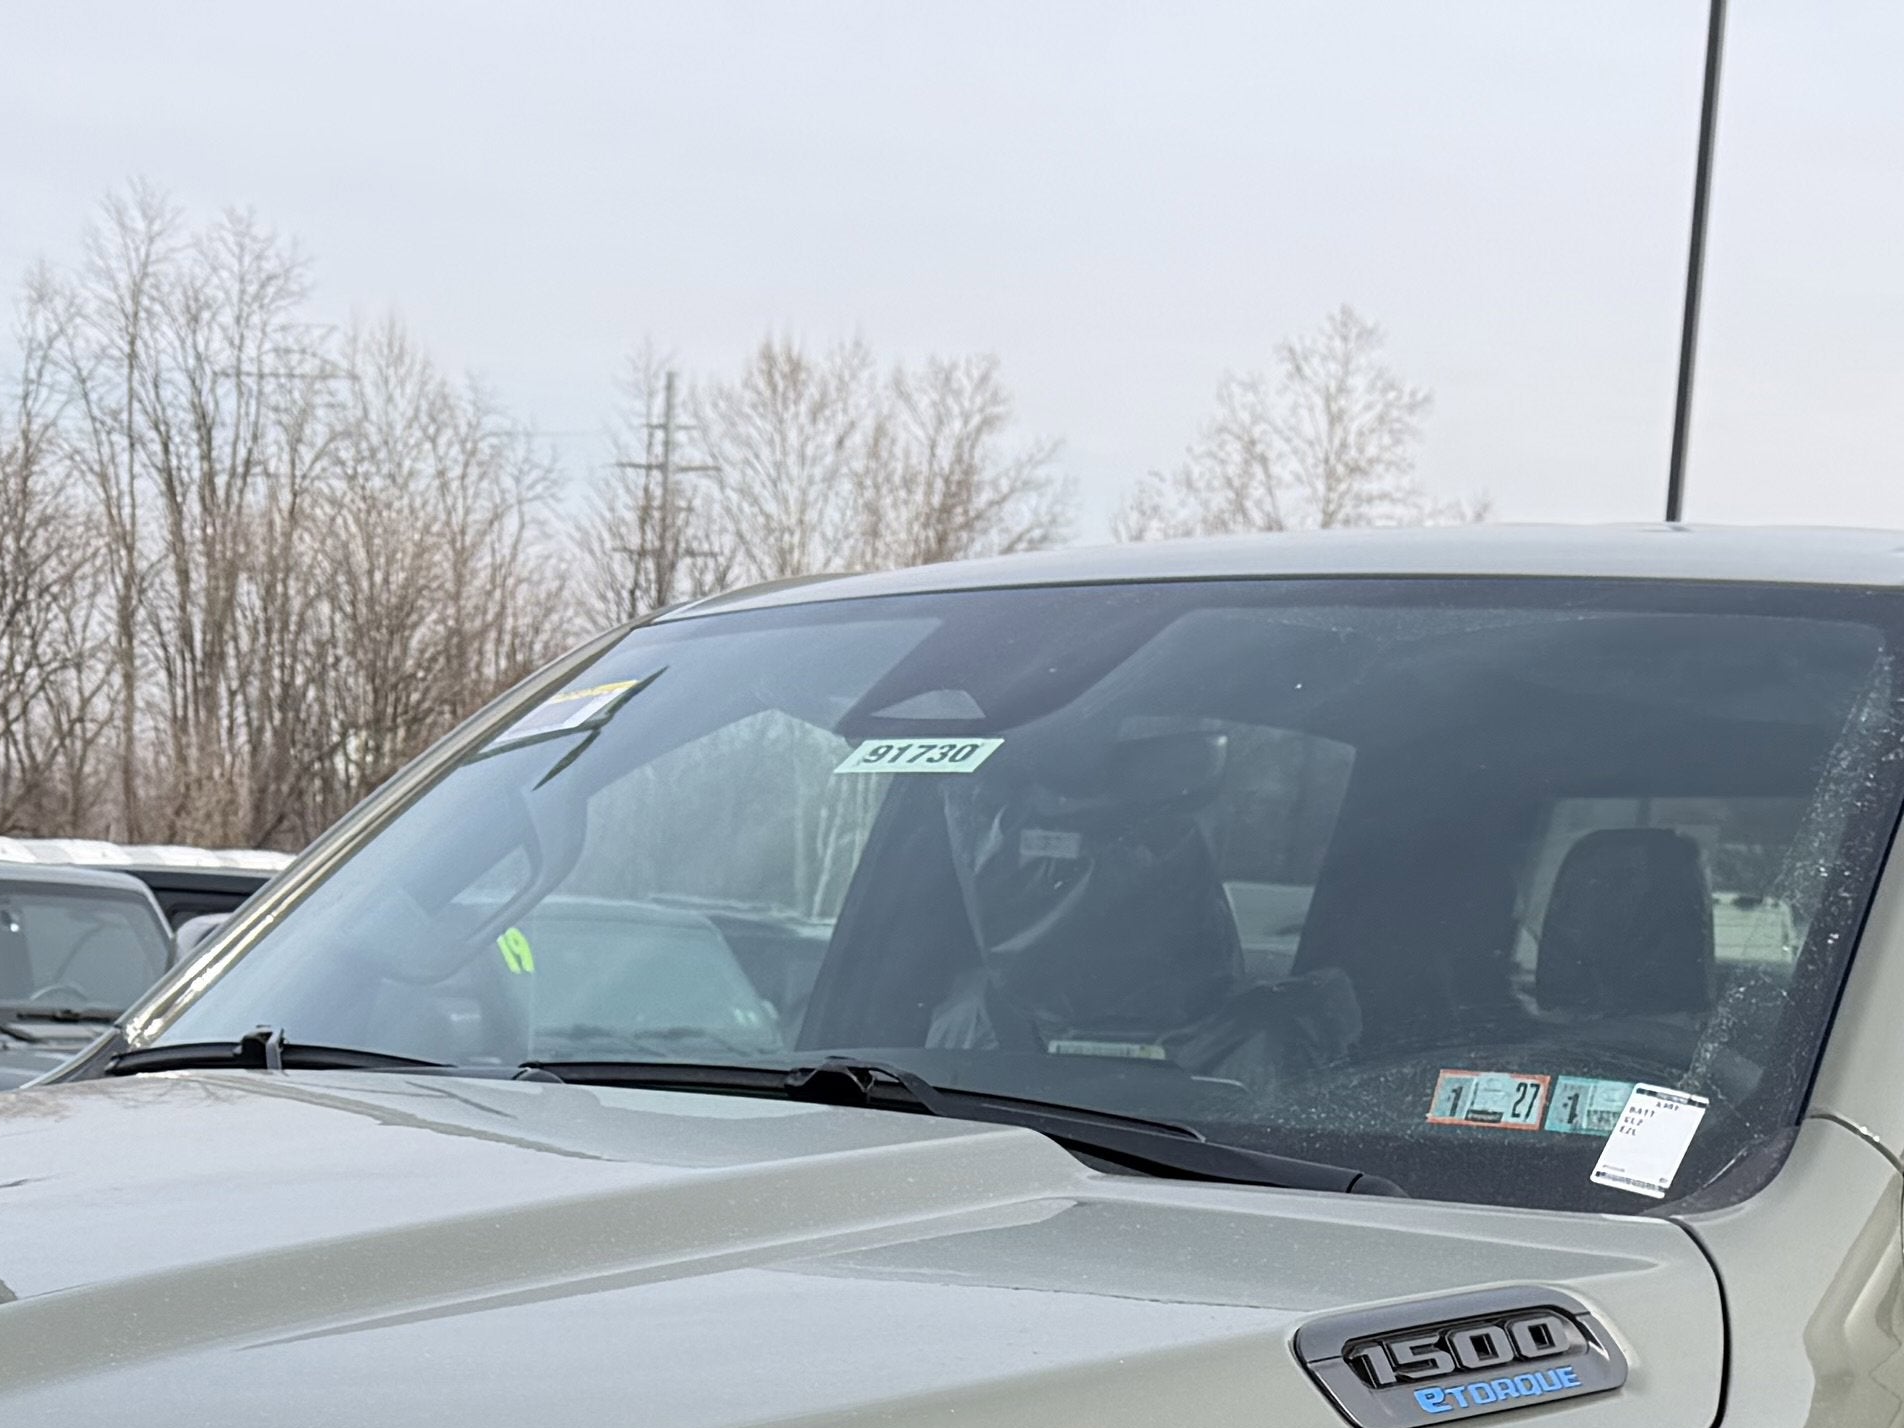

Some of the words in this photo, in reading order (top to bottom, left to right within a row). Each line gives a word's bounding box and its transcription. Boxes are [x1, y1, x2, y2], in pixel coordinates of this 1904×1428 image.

[862, 743, 980, 764] 91730
[496, 926, 535, 975] 19
[1449, 1085, 1464, 1117] 1
[1510, 1081, 1542, 1122] 27
[1348, 1316, 1572, 1386] 1500
